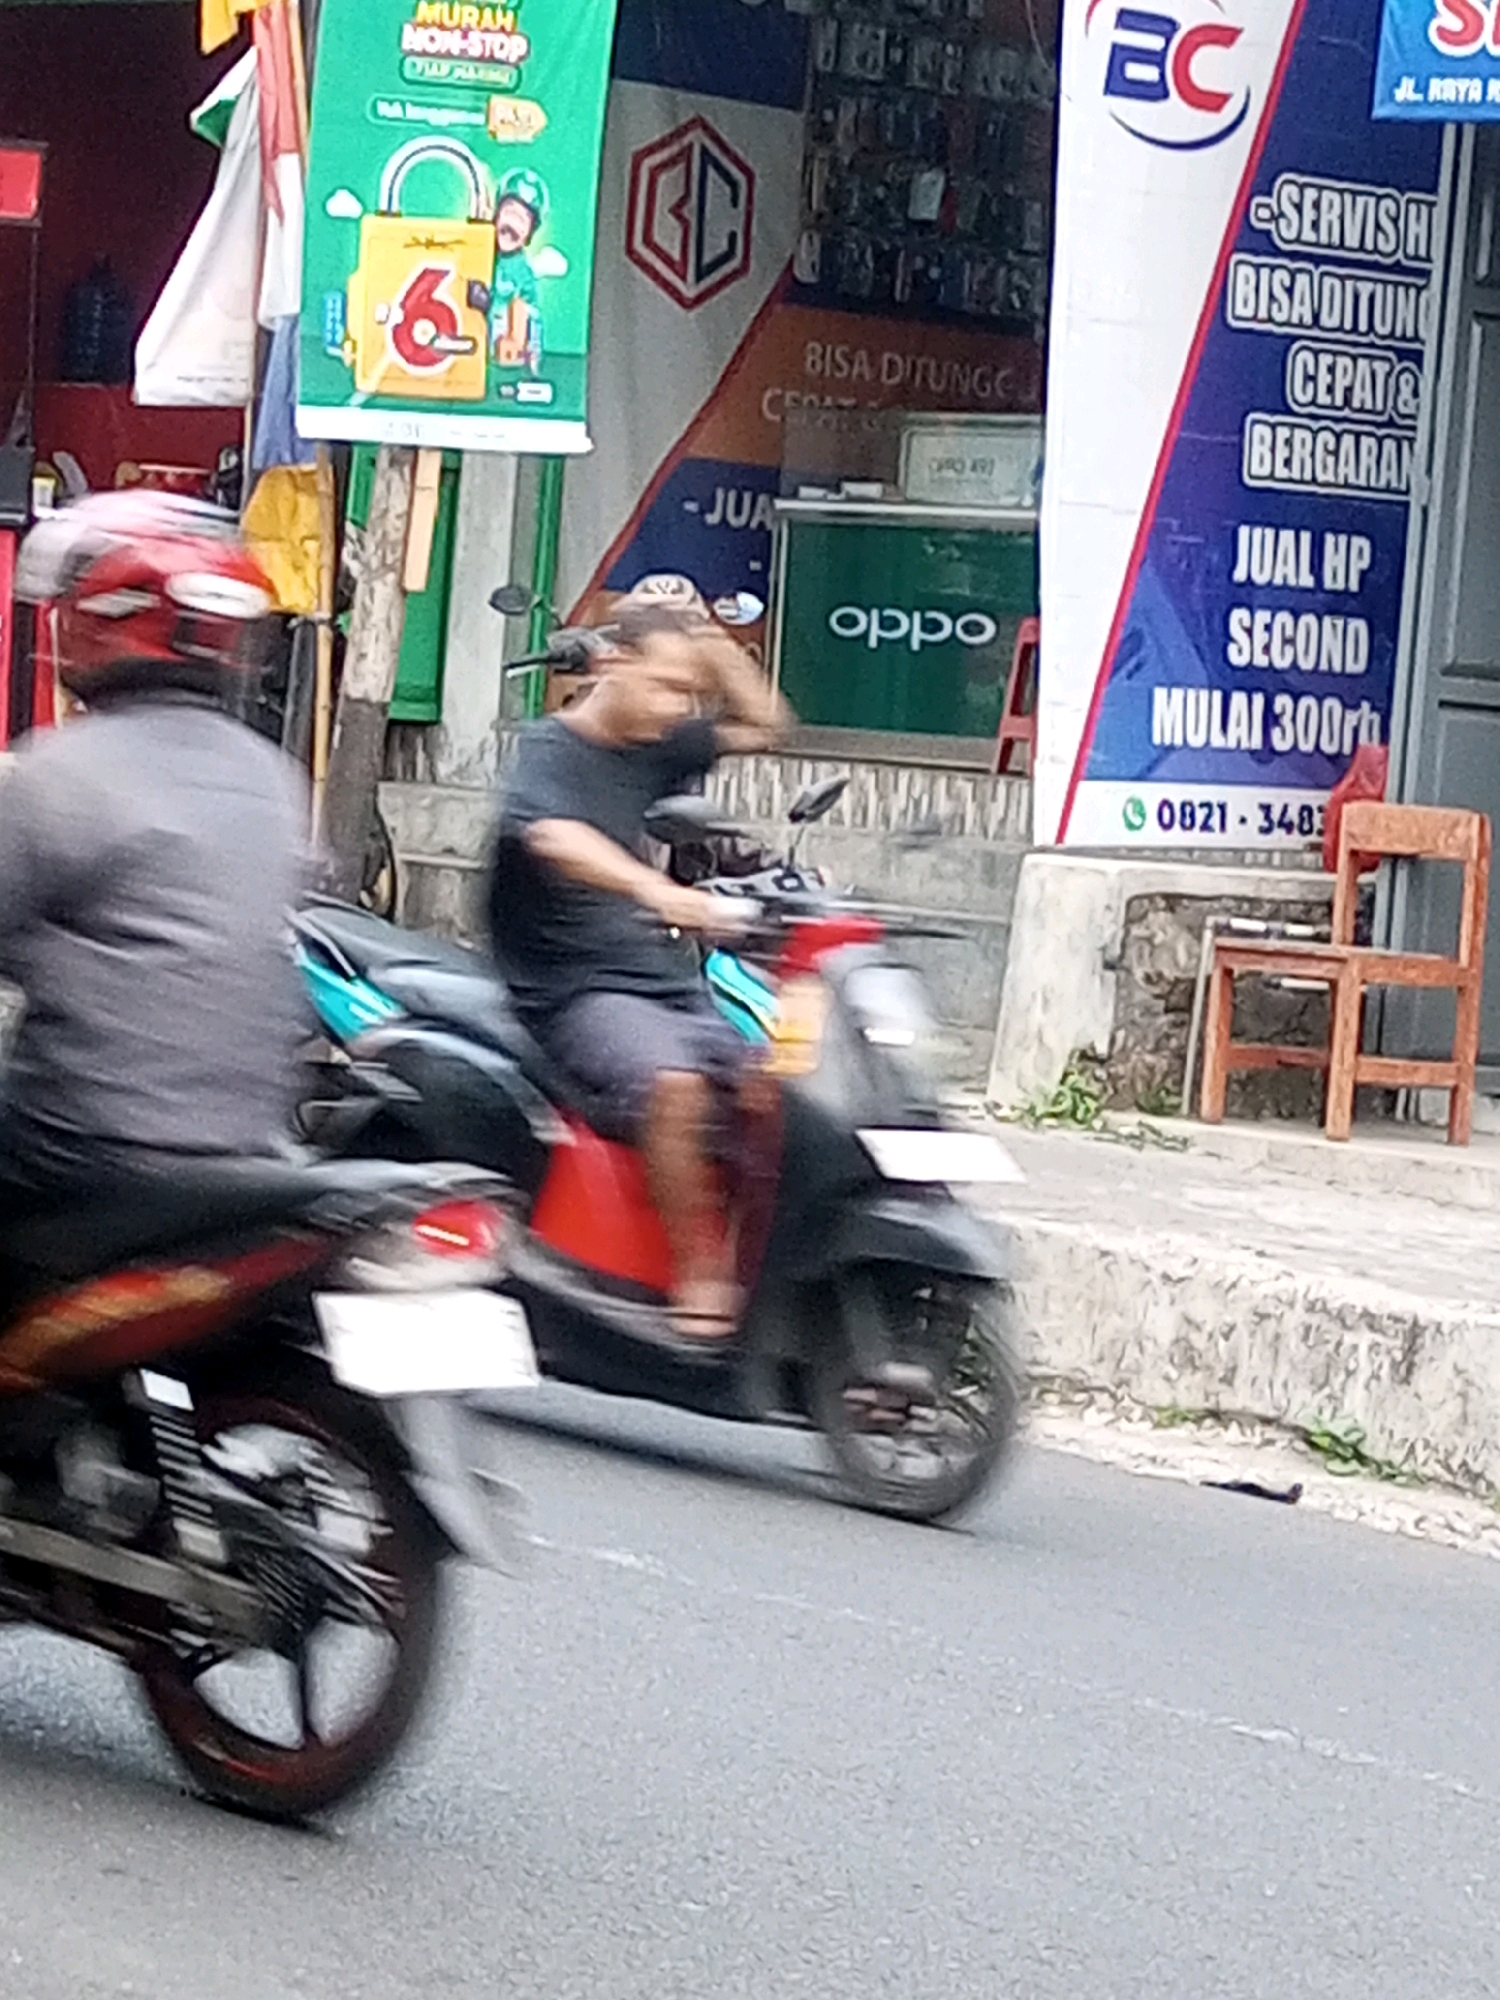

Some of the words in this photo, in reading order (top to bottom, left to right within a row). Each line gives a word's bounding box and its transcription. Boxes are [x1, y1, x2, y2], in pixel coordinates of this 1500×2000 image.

[402, 23, 529, 63] NON-STOP
[416, 1, 515, 32] MURAH
[1234, 263, 1313, 326] BISA
[805, 342, 871, 382] BISA
[1293, 350, 1390, 412] CEPAT
[1397, 369, 1419, 415] &
[1233, 524, 1315, 588] JUAL
[1323, 532, 1372, 592] HP
[1227, 607, 1369, 674] SECOND
[1152, 687, 1264, 749] MULAI
[1271, 693, 1382, 756] 300rb
[1157, 798, 1227, 833] 0821
